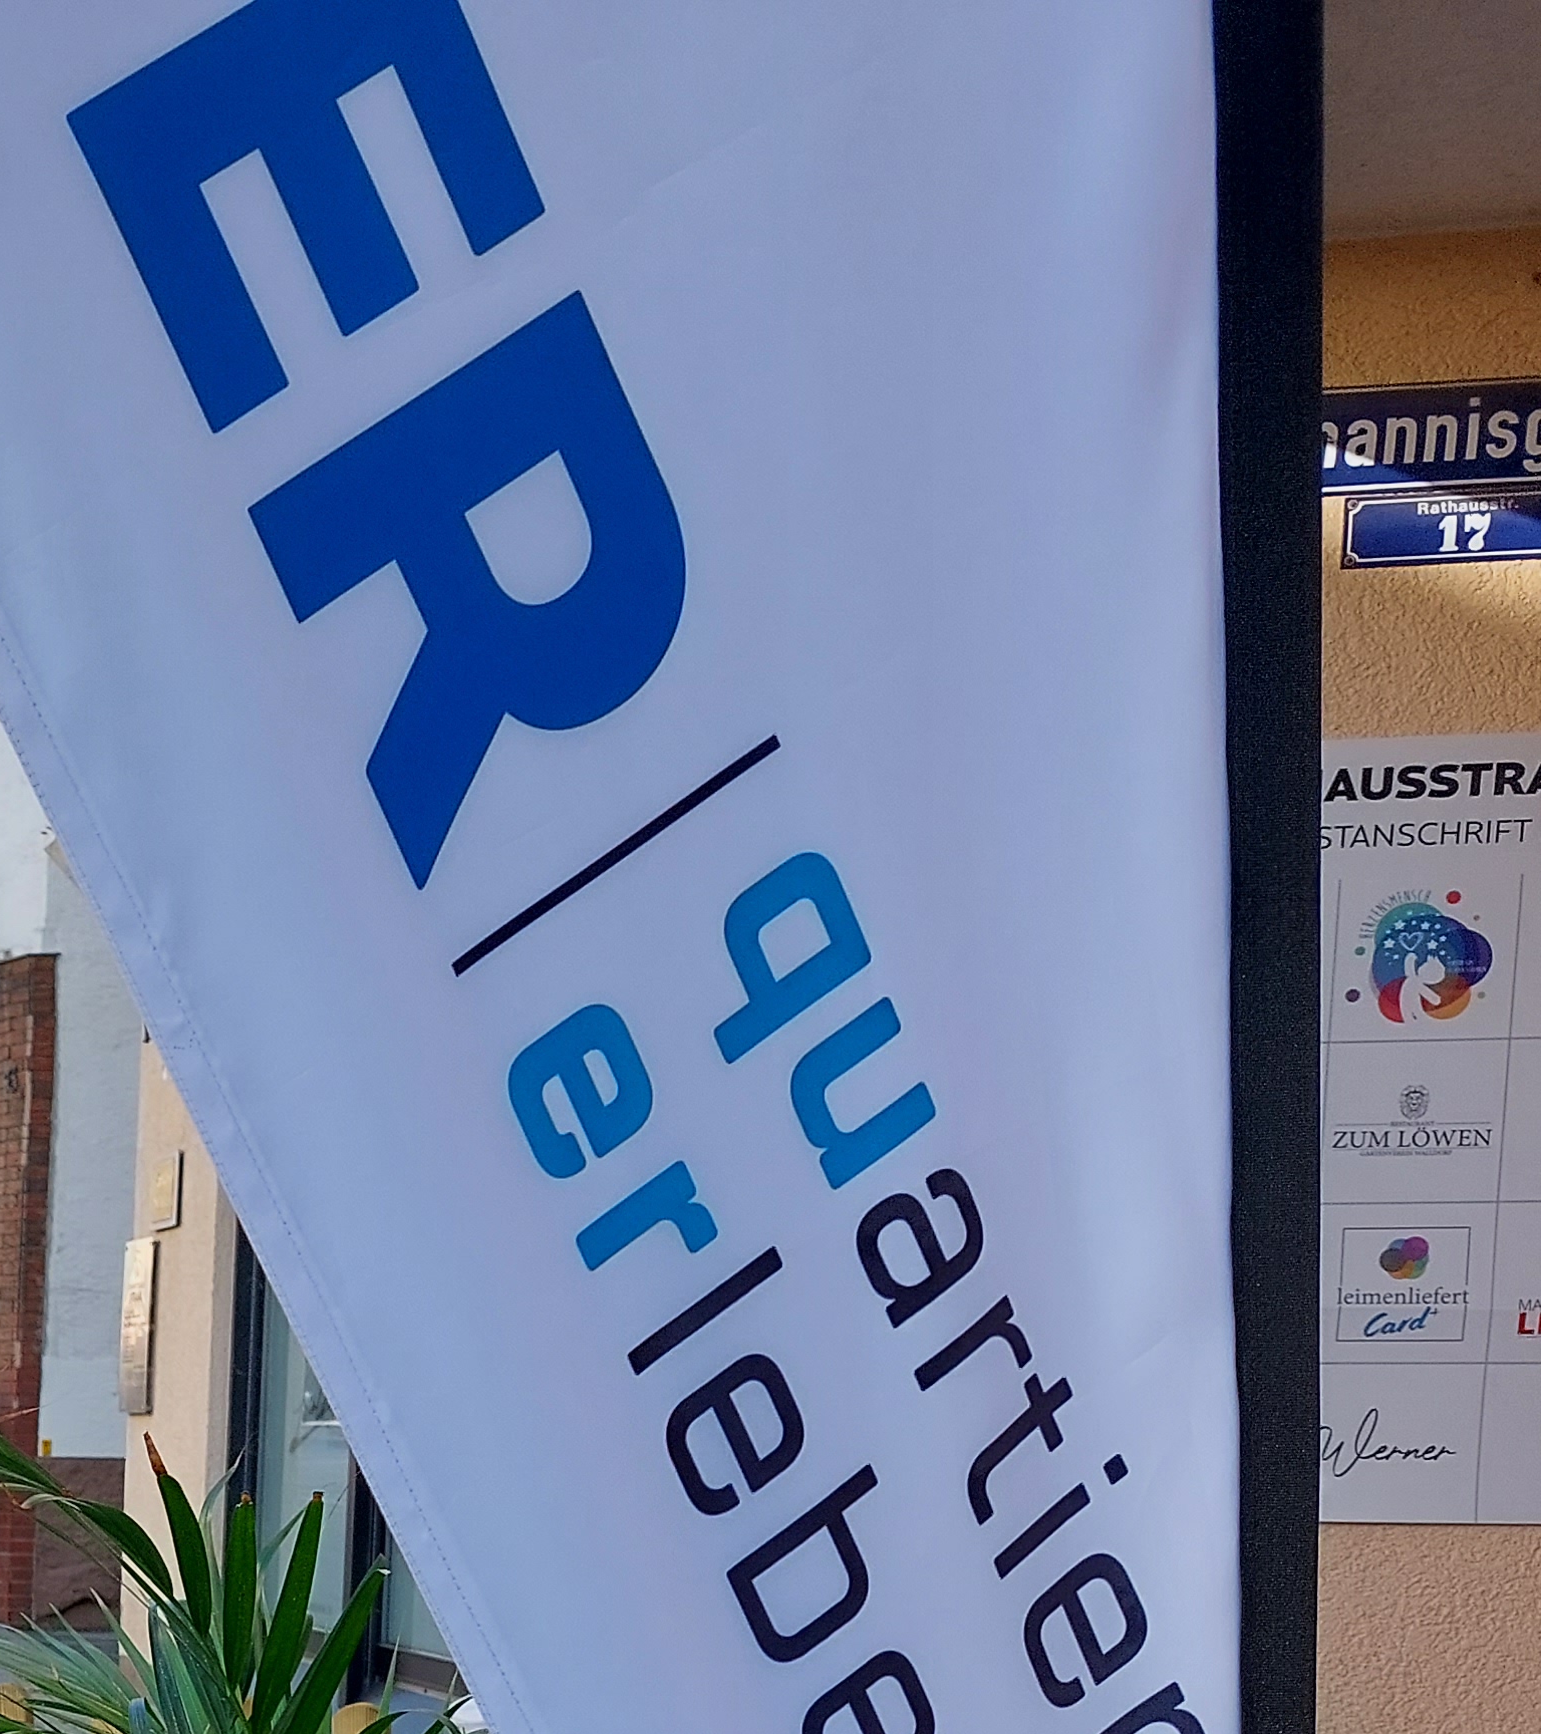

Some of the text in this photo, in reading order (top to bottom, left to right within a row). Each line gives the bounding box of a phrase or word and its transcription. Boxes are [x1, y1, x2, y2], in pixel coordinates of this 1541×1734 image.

[1417, 499, 1519, 515] Rathausstr.
[1438, 513, 1492, 551] 17
[1332, 1126, 1494, 1148] ZUM LÖWEN
[1337, 1284, 1469, 1306] leimenliefert
